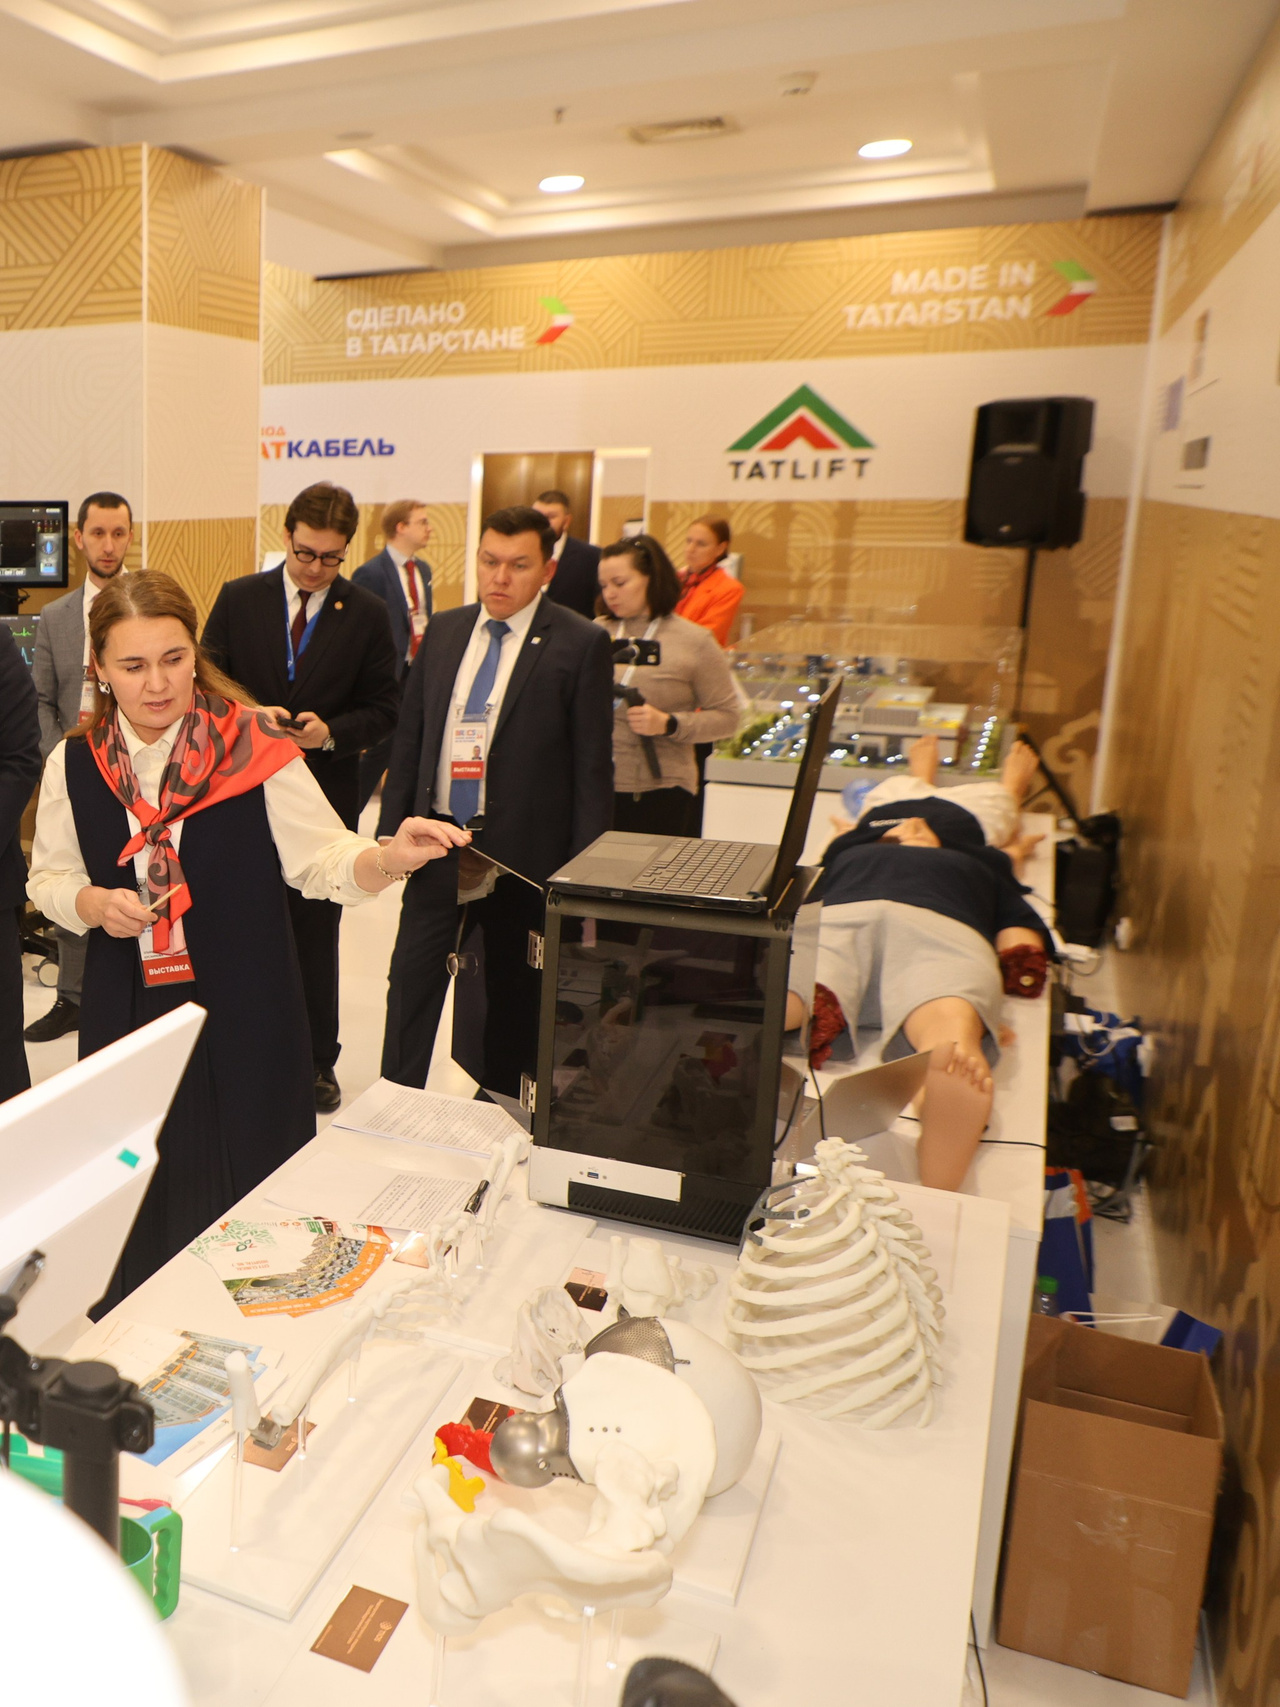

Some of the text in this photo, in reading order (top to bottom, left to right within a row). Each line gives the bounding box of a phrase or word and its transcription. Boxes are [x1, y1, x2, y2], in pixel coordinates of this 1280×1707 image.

[890, 261, 1036, 296] MADE IN
[346, 301, 466, 331] СДЕЛАНО
[841, 293, 1033, 330] TATARSTAN
[346, 326, 526, 357] В ТАТАРСТАНЕ
[261, 426, 286, 436] ОД
[728, 458, 872, 481] TATLIFT
[148, 963, 190, 976] ВЫСТАВКА
